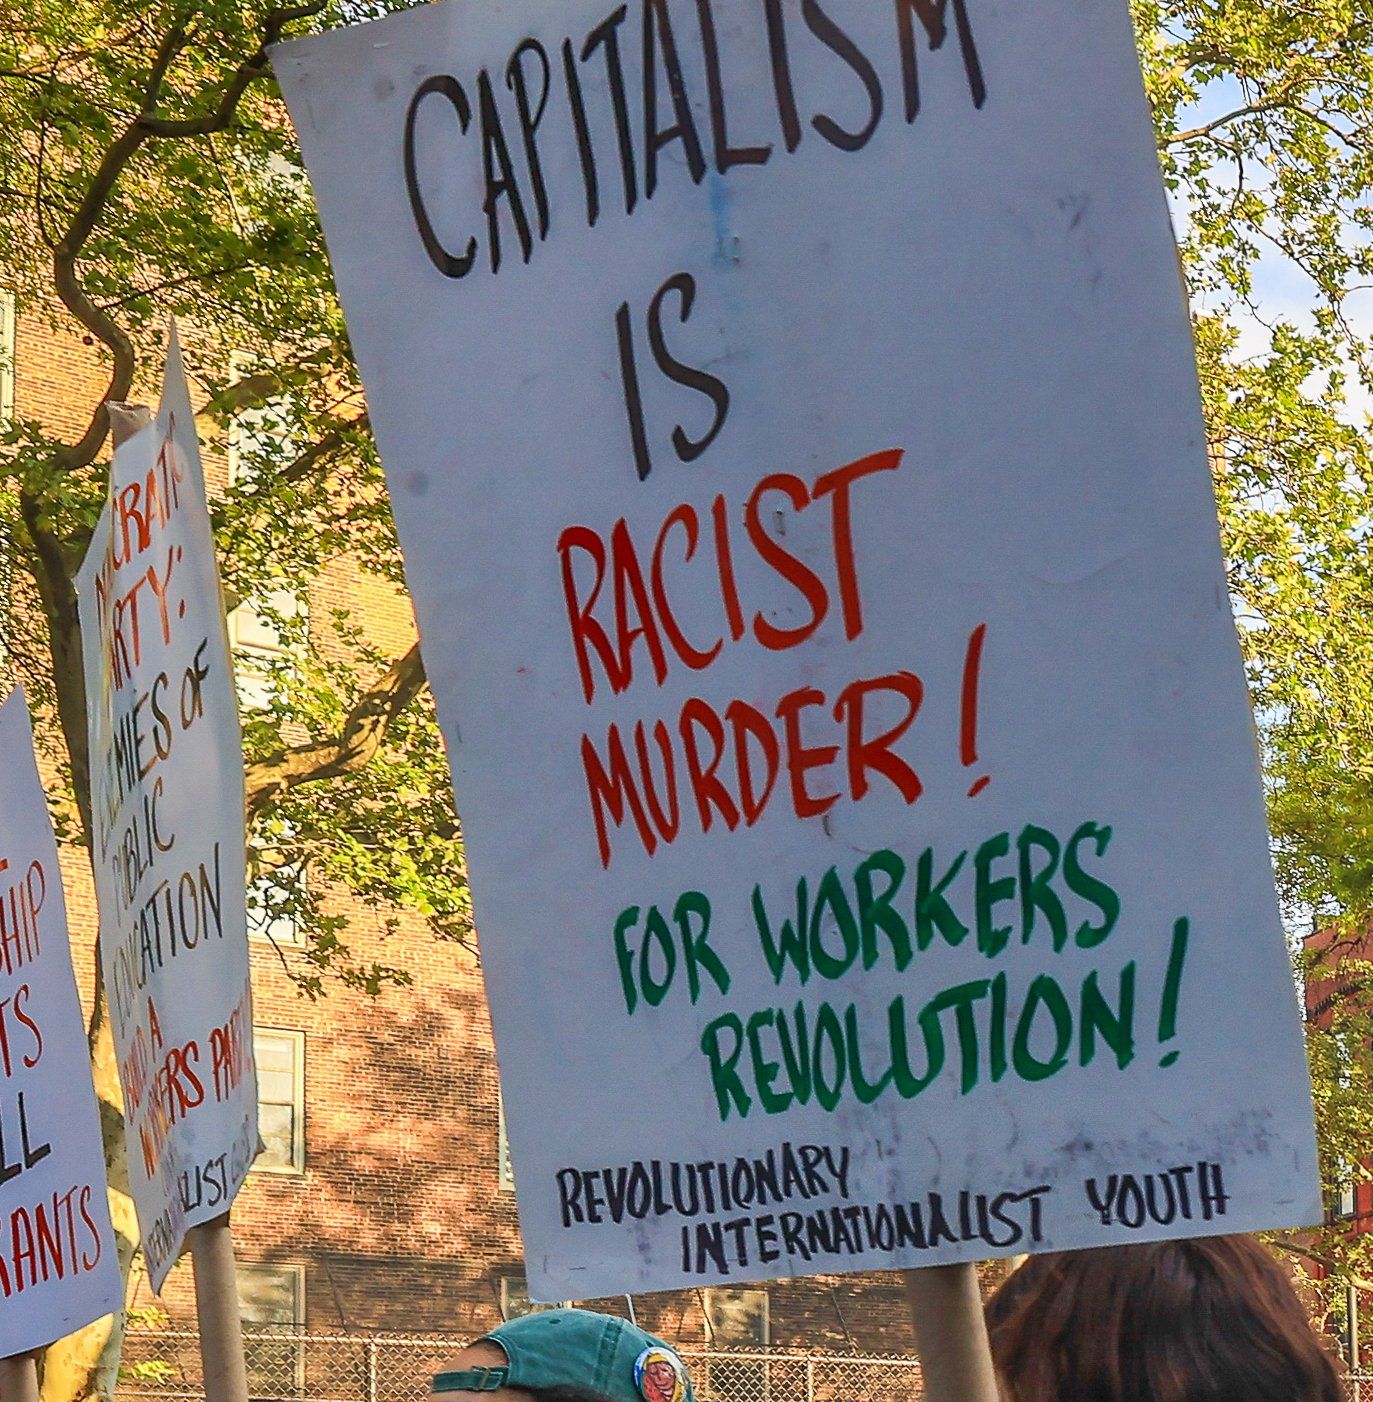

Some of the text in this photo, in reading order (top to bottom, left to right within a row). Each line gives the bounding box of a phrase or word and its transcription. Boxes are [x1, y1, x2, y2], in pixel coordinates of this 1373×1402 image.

[403, 0, 987, 279] CAPITALISM
[614, 272, 729, 481] IS
[557, 448, 905, 704] RACIST
[180, 636, 210, 730] OF
[580, 624, 991, 868] MURDER!
[614, 820, 1120, 1016] FOR WORKERS
[147, 995, 163, 1063] A
[701, 916, 1189, 1121] REVOLUTION!
[557, 1144, 850, 1227] REVOLUTIONARY
[682, 1164, 1229, 1274] INTERNATIONALIST YOUTH
